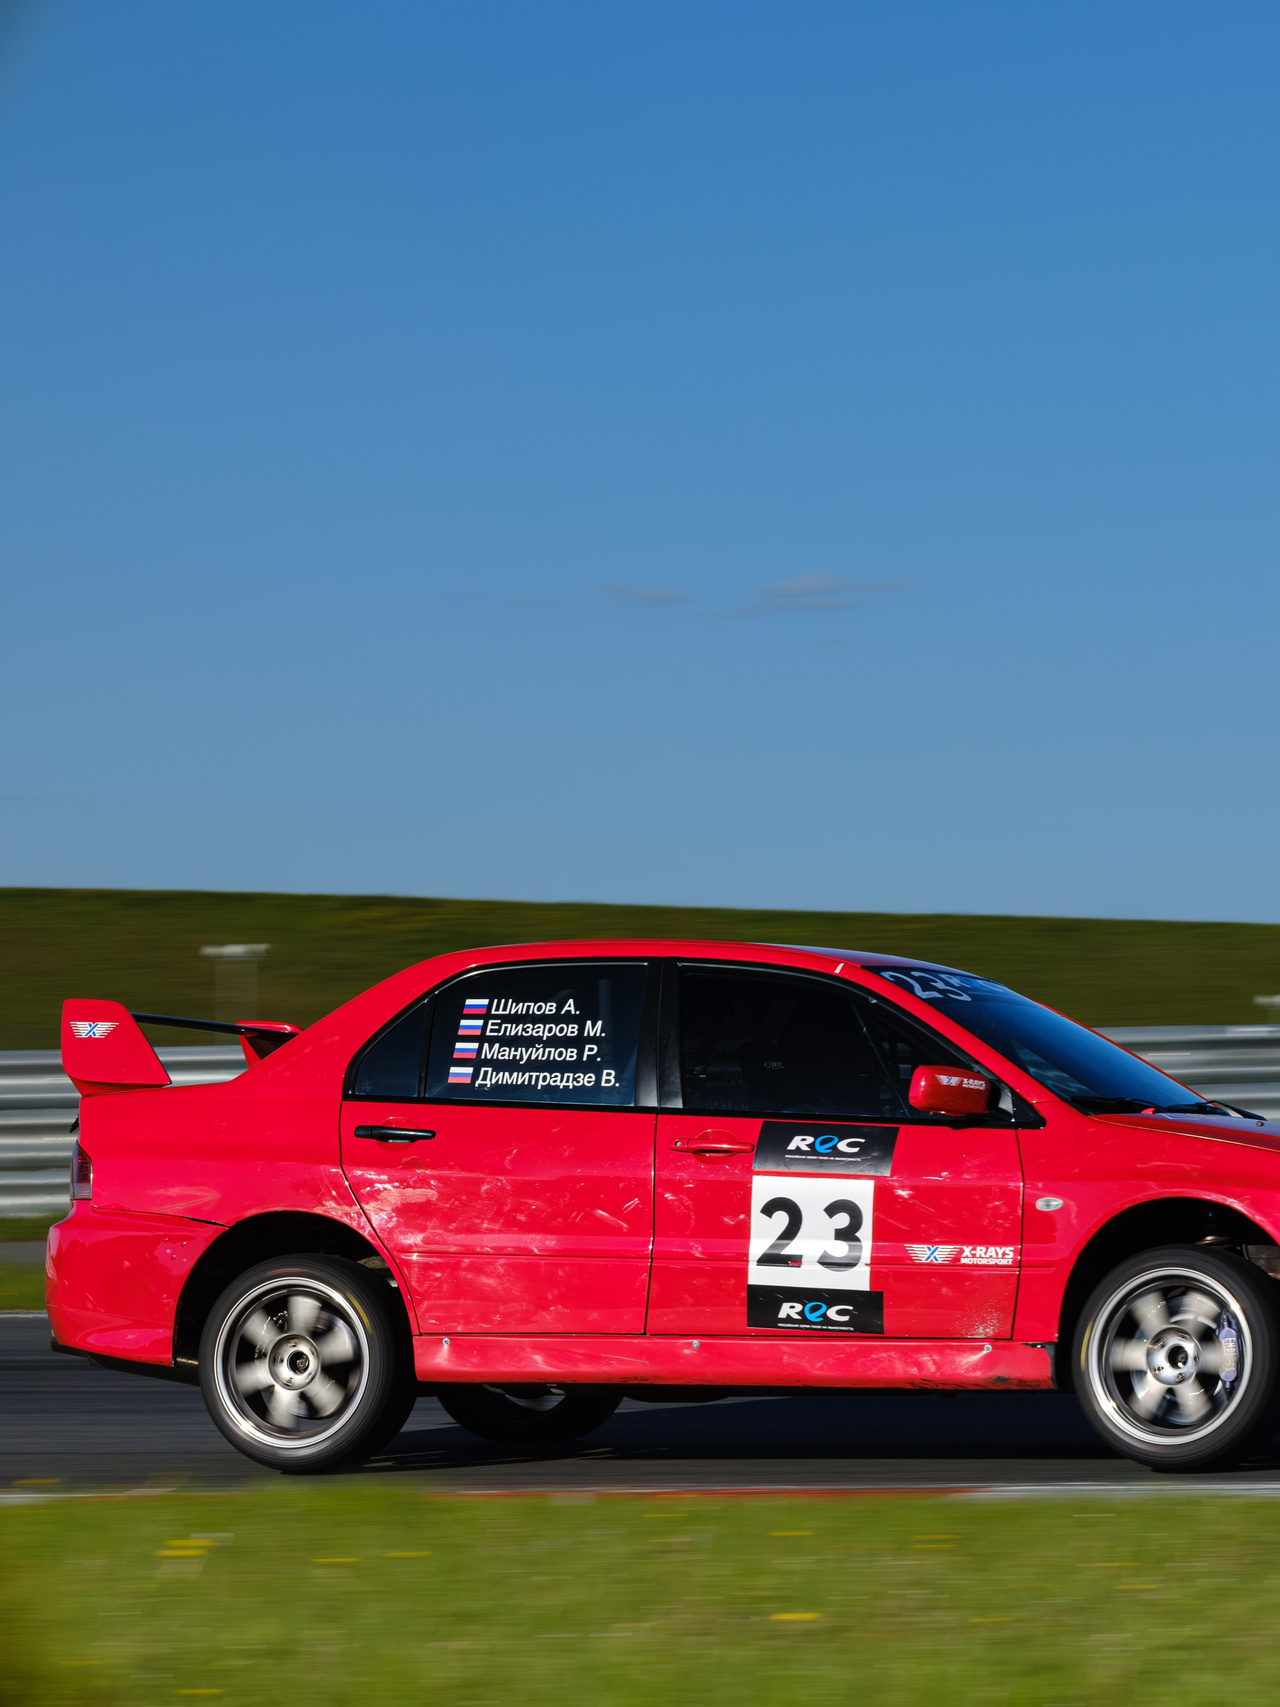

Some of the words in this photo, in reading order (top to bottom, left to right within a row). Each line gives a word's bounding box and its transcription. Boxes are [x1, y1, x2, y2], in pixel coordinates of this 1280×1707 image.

[880, 971, 972, 1002] 23
[491, 999, 556, 1014] Шипов
[561, 999, 579, 1014] А.
[486, 1020, 578, 1040] Елизаров
[584, 1020, 605, 1036] М.
[481, 1043, 577, 1064] Мануйлов
[583, 1045, 601, 1061] Р.
[475, 1067, 595, 1090] Димитрадзе
[601, 1070, 619, 1087] В.
[756, 1197, 864, 1272] 23
[960, 1257, 1013, 1265] MOTORSPORT
[961, 1246, 1014, 1258] X-RAYS
